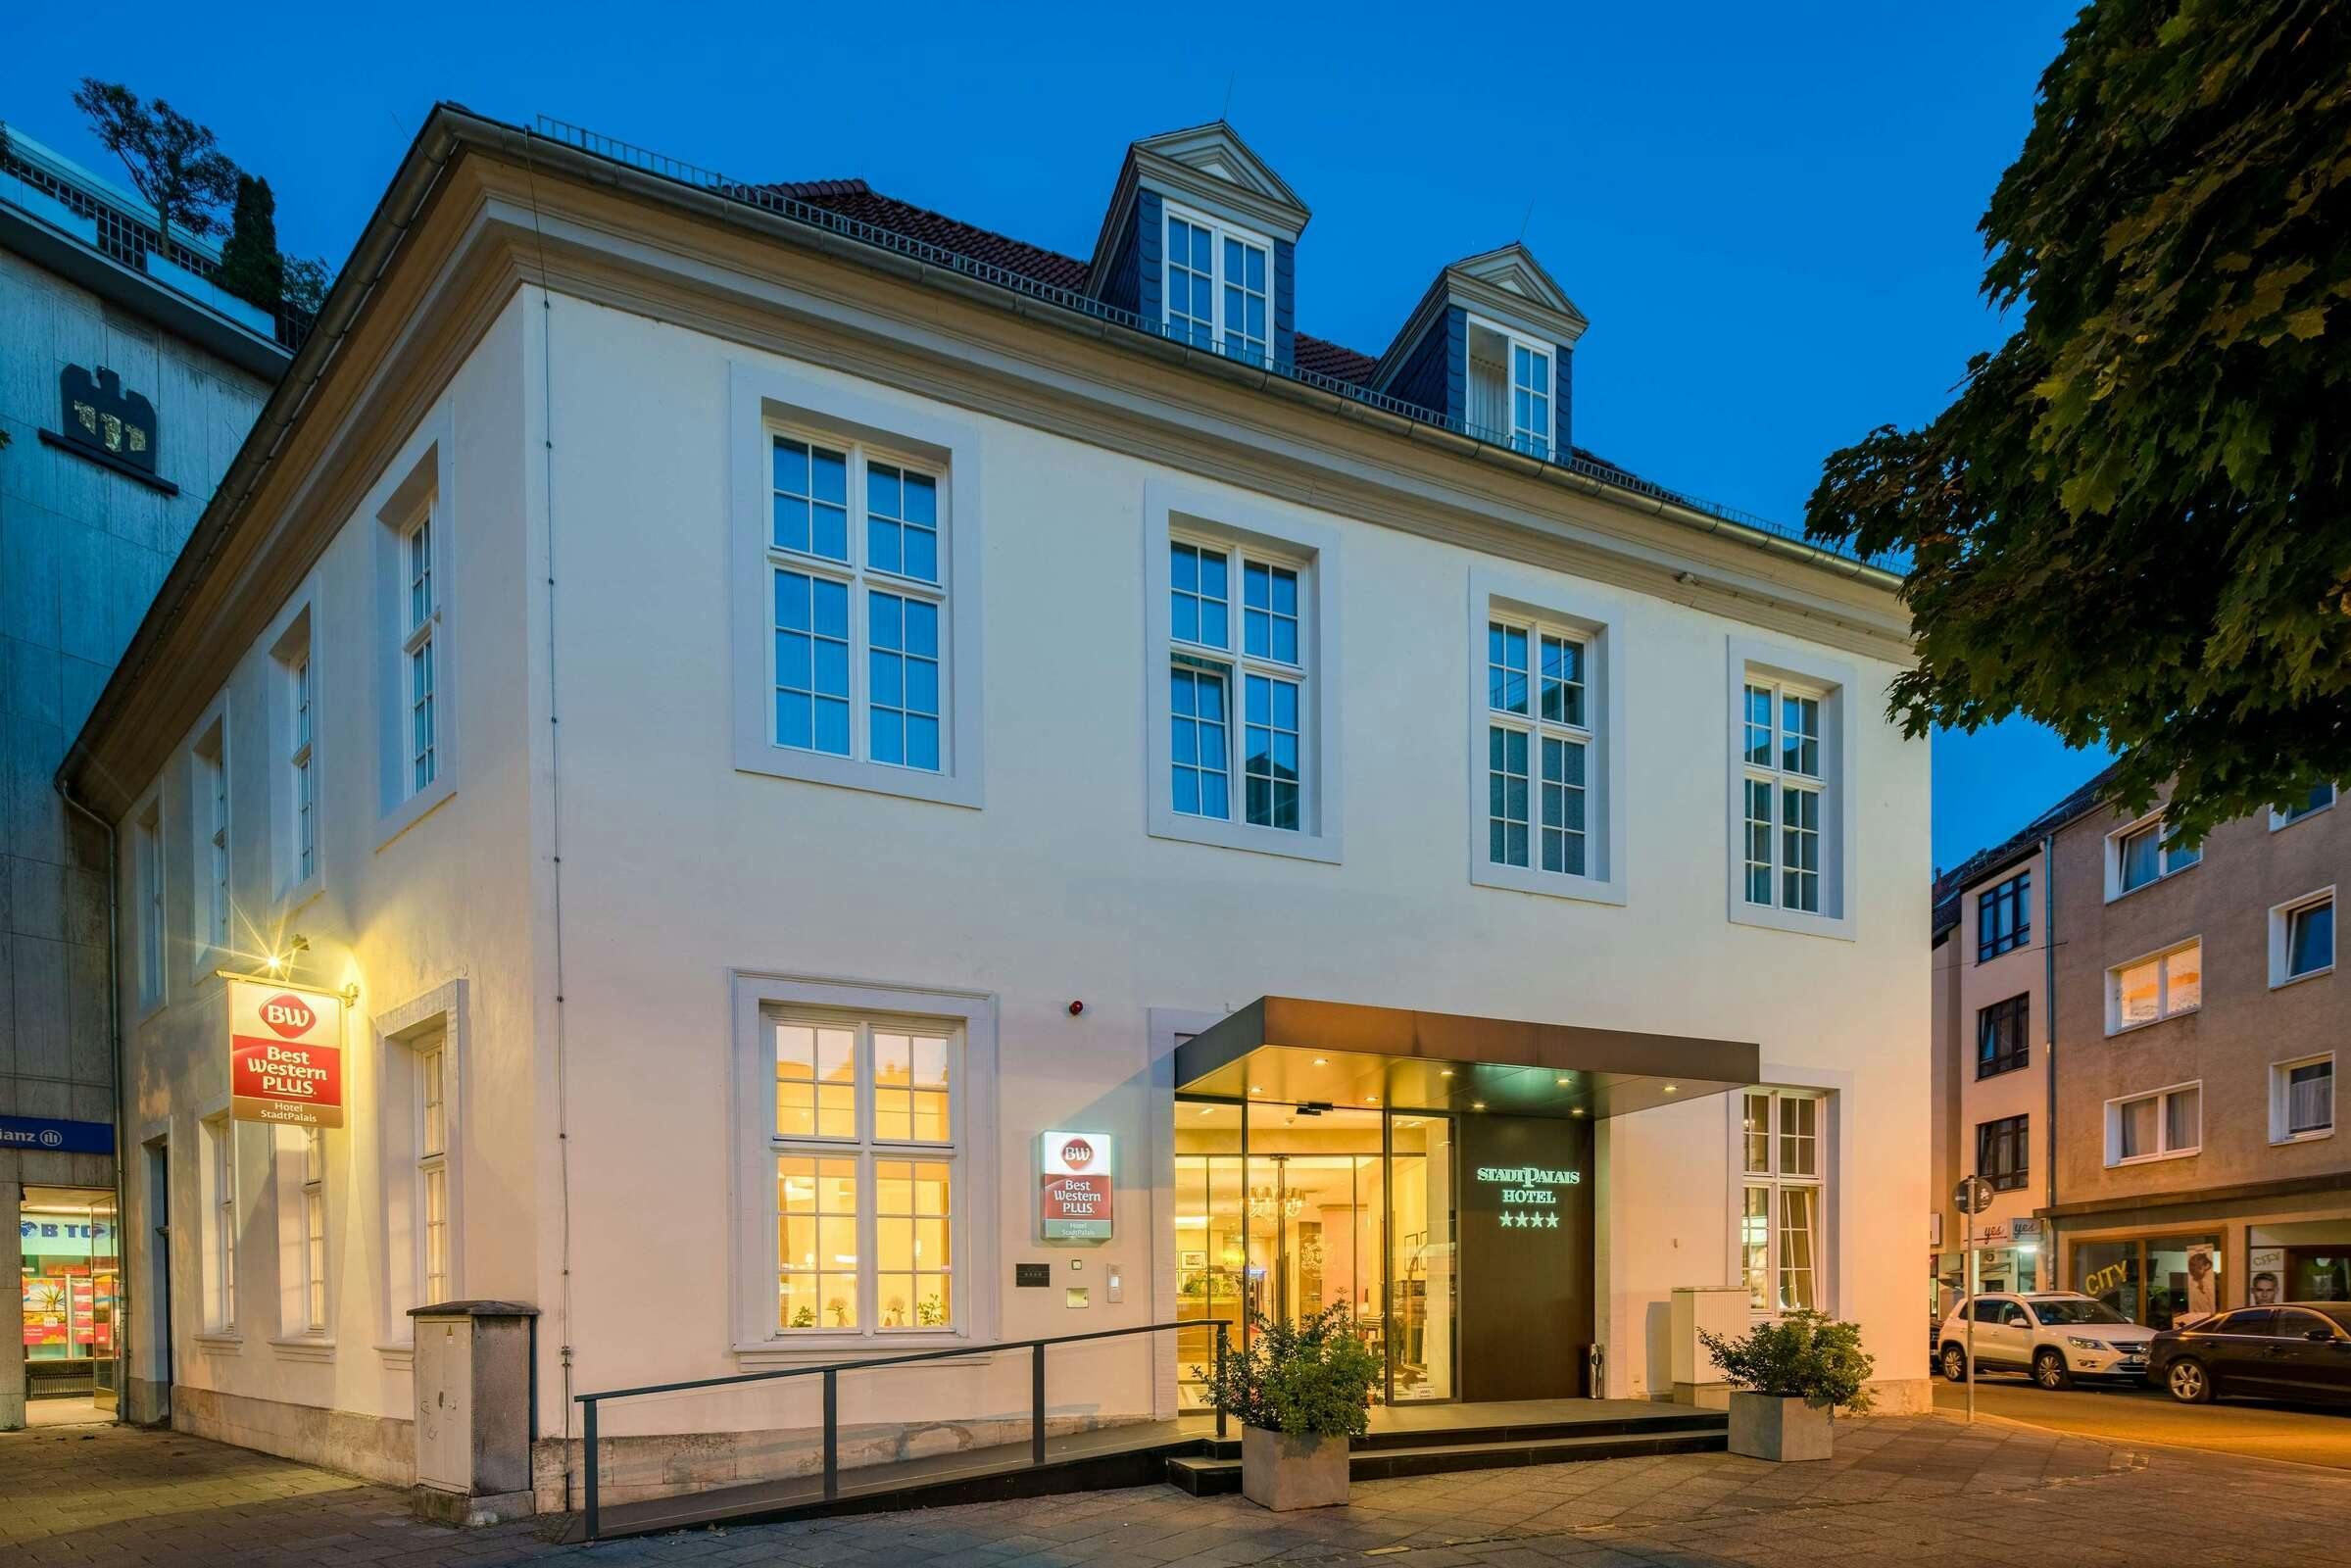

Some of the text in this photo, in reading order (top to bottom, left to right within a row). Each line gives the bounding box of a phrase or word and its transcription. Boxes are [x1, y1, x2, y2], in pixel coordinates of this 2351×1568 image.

[268, 1004, 310, 1028] BW
[268, 1046, 310, 1065] Best
[247, 1058, 327, 1081] Western
[274, 1102, 303, 1112] Hotel
[261, 1109, 317, 1123] StadtPalais
[1065, 1147, 1090, 1160] BW
[1477, 1167, 1581, 1188] STADTPALAIS
[1065, 1180, 1090, 1192] Best
[1053, 1190, 1102, 1201] Western
[1501, 1190, 1556, 1203] HOTEL
[2085, 1259, 2129, 1295] CITY
